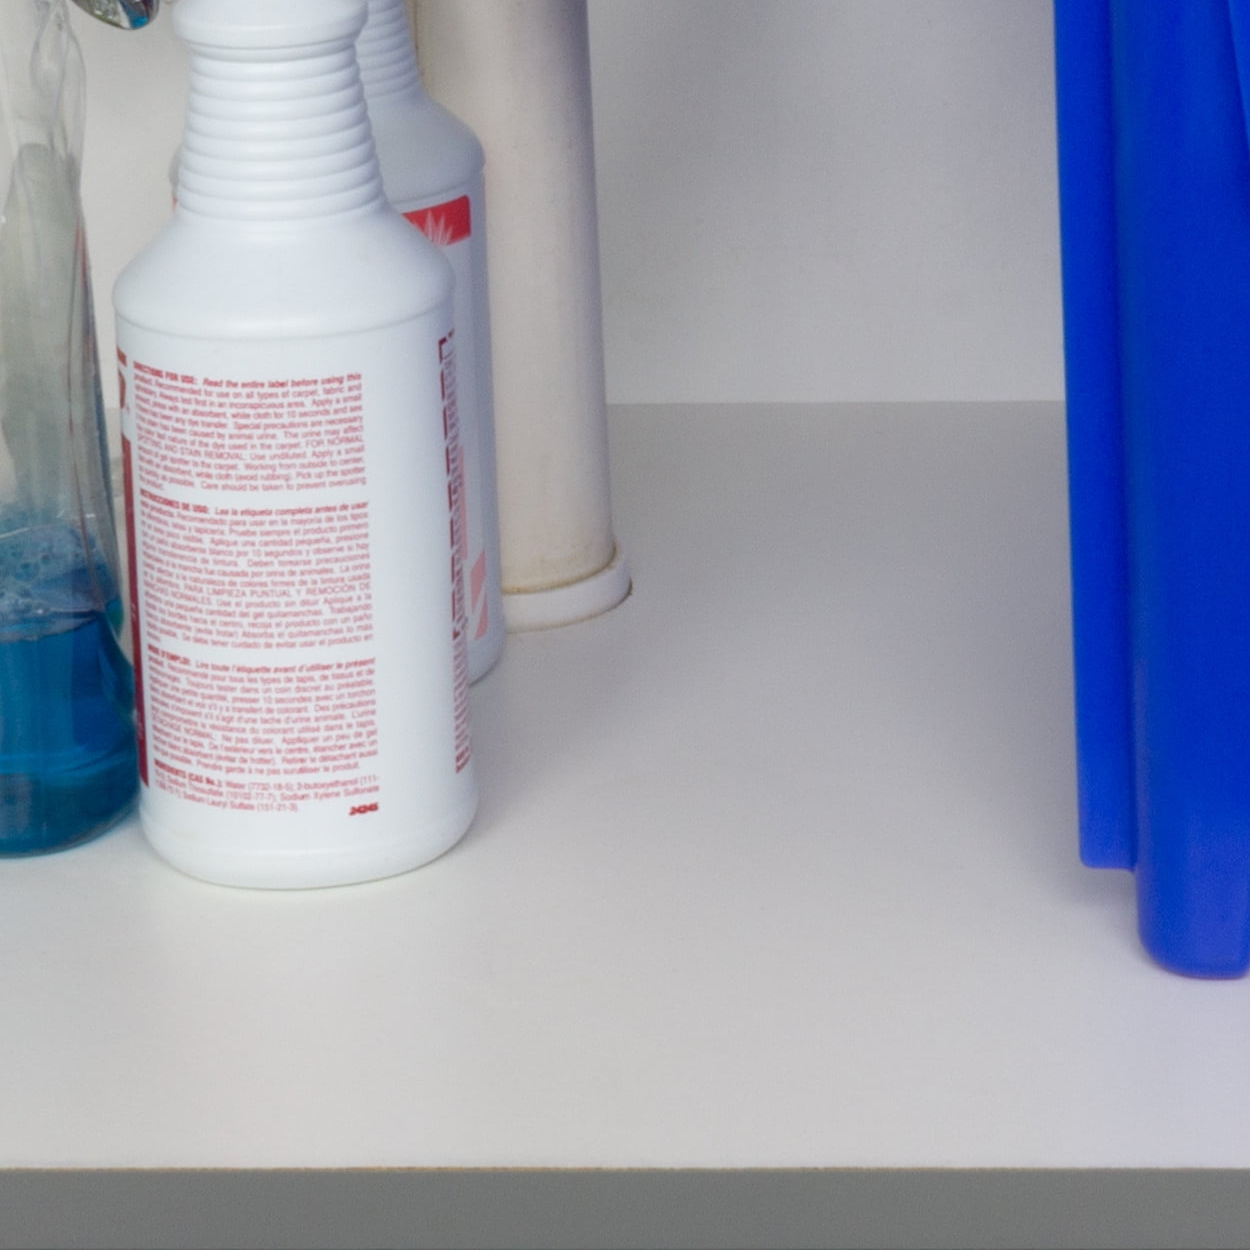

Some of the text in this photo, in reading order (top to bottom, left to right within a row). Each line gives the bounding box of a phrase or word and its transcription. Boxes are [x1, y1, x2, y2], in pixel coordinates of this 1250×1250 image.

[290, 377, 318, 386] before
[321, 374, 344, 385] using
[346, 371, 362, 381] this
[322, 385, 344, 394] fabric
[347, 382, 363, 391] and
[311, 397, 333, 407] Apply
[342, 393, 363, 403] small
[286, 410, 297, 418] 10
[298, 407, 331, 417] seconds
[332, 405, 348, 414] and
[283, 423, 364, 438] The urine may affect
[304, 438, 325, 447] FOR
[327, 434, 363, 445] NORMAL
[311, 448, 333, 458] Apply
[344, 444, 366, 453] small
[299, 459, 327, 468] outside
[329, 458, 337, 466] to
[295, 465, 366, 479] Pick up the spotter
[285, 482, 294, 490] to
[296, 480, 326, 491] prevent
[315, 503, 337, 512] antes
[339, 502, 349, 510] de
[351, 501, 369, 509] usar
[324, 514, 334, 522] de
[336, 512, 348, 521] los
[350, 510, 369, 521] tipos
[293, 520, 369, 536] el producto primero
[335, 530, 370, 543] presione
[312, 544, 344, 554] observe
[346, 543, 353, 551] si
[355, 541, 370, 551] hay
[339, 564, 350, 572] La
[351, 561, 371, 571] orina
[298, 571, 372, 586] de la tintura usada
[358, 581, 371, 589] DE
[323, 594, 353, 606] Aplique
[364, 591, 373, 599] la
[346, 624, 354, 632] lo
[327, 634, 362, 646] producto
[335, 660, 343, 668] le
[319, 672, 329, 680] de
[331, 670, 354, 679] tissus
[355, 668, 363, 677] et
[365, 667, 376, 675] de
[294, 683, 321, 692] discret
[347, 687, 376, 698] torchon
[313, 703, 330, 711] Des
[323, 722, 343, 731] dans
[345, 721, 353, 729] le
[335, 733, 350, 742] peu
[353, 729, 363, 738] de
[366, 727, 378, 738] gel
[348, 741, 365, 749] avec
[309, 755, 317, 763] le
[358, 747, 379, 757] aussi
[322, 764, 330, 772] le
[313, 789, 341, 800] Xylene
